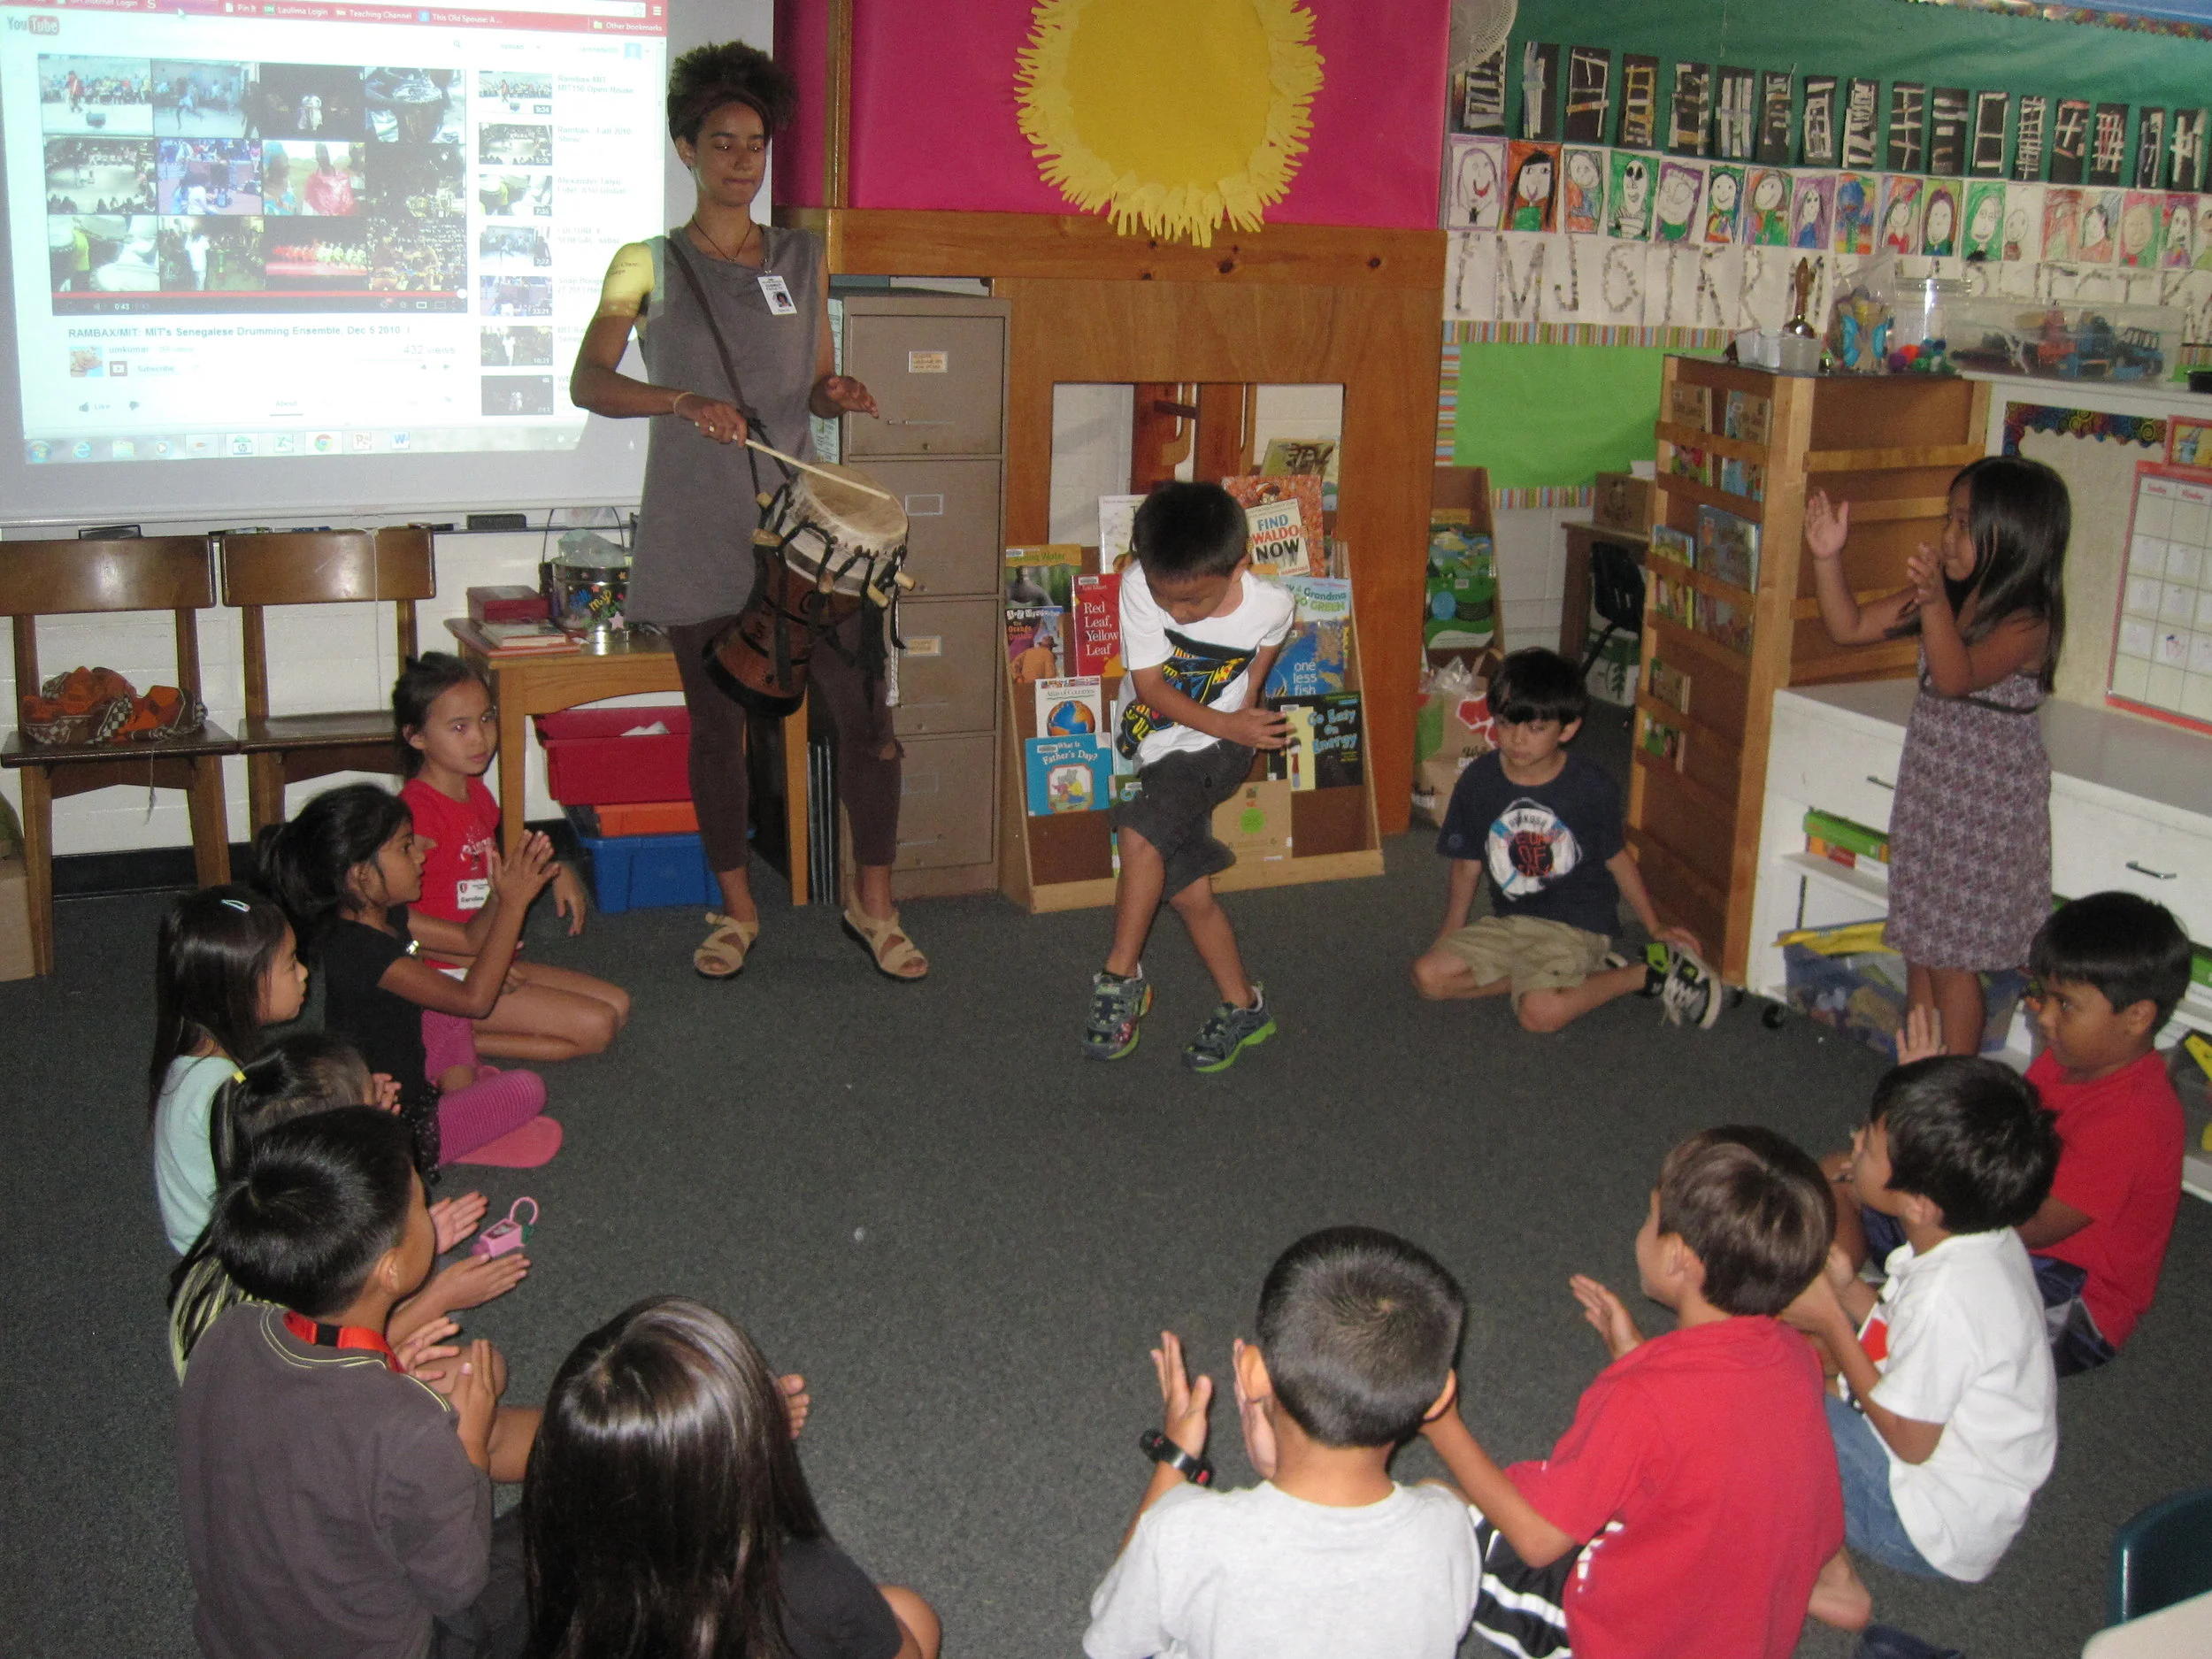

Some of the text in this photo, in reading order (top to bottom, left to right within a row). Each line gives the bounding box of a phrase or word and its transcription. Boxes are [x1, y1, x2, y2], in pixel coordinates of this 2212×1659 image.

[308, 8, 328, 17] Login
[349, 9, 382, 19] Teaching
[383, 11, 412, 19] Channel
[462, 15, 488, 25] Spouse:
[606, 21, 663, 32] Other bookmarks
[587, 85, 608, 95] Open
[68, 327, 142, 338] RAMBAX/MIT:
[145, 327, 173, 337] MIT's
[176, 326, 234, 338] Senegalese
[237, 326, 289, 337] Drumming
[292, 326, 344, 336] Ensemble,
[347, 326, 365, 334] Dec
[369, 326, 375, 334] 5
[378, 326, 401, 334] 2010
[403, 345, 457, 355] 432 views
[1257, 513, 1289, 532] FIND
[1252, 525, 1300, 545] WALDO
[1256, 537, 1300, 562] NOW
[1304, 587, 1347, 601] Grandma
[1083, 601, 1105, 615] Red
[1310, 600, 1346, 613] GREEN
[1085, 615, 1113, 629] Leaf,
[1086, 630, 1119, 642] Yellow
[1086, 643, 1112, 657] Leaf
[1294, 661, 1317, 672] one
[1293, 672, 1317, 684] less
[1294, 684, 1317, 696] fish
[1307, 708, 1356, 726] Go Easy
[1311, 733, 1358, 755] Energy
[1041, 749, 1098, 765] Father's Day?
